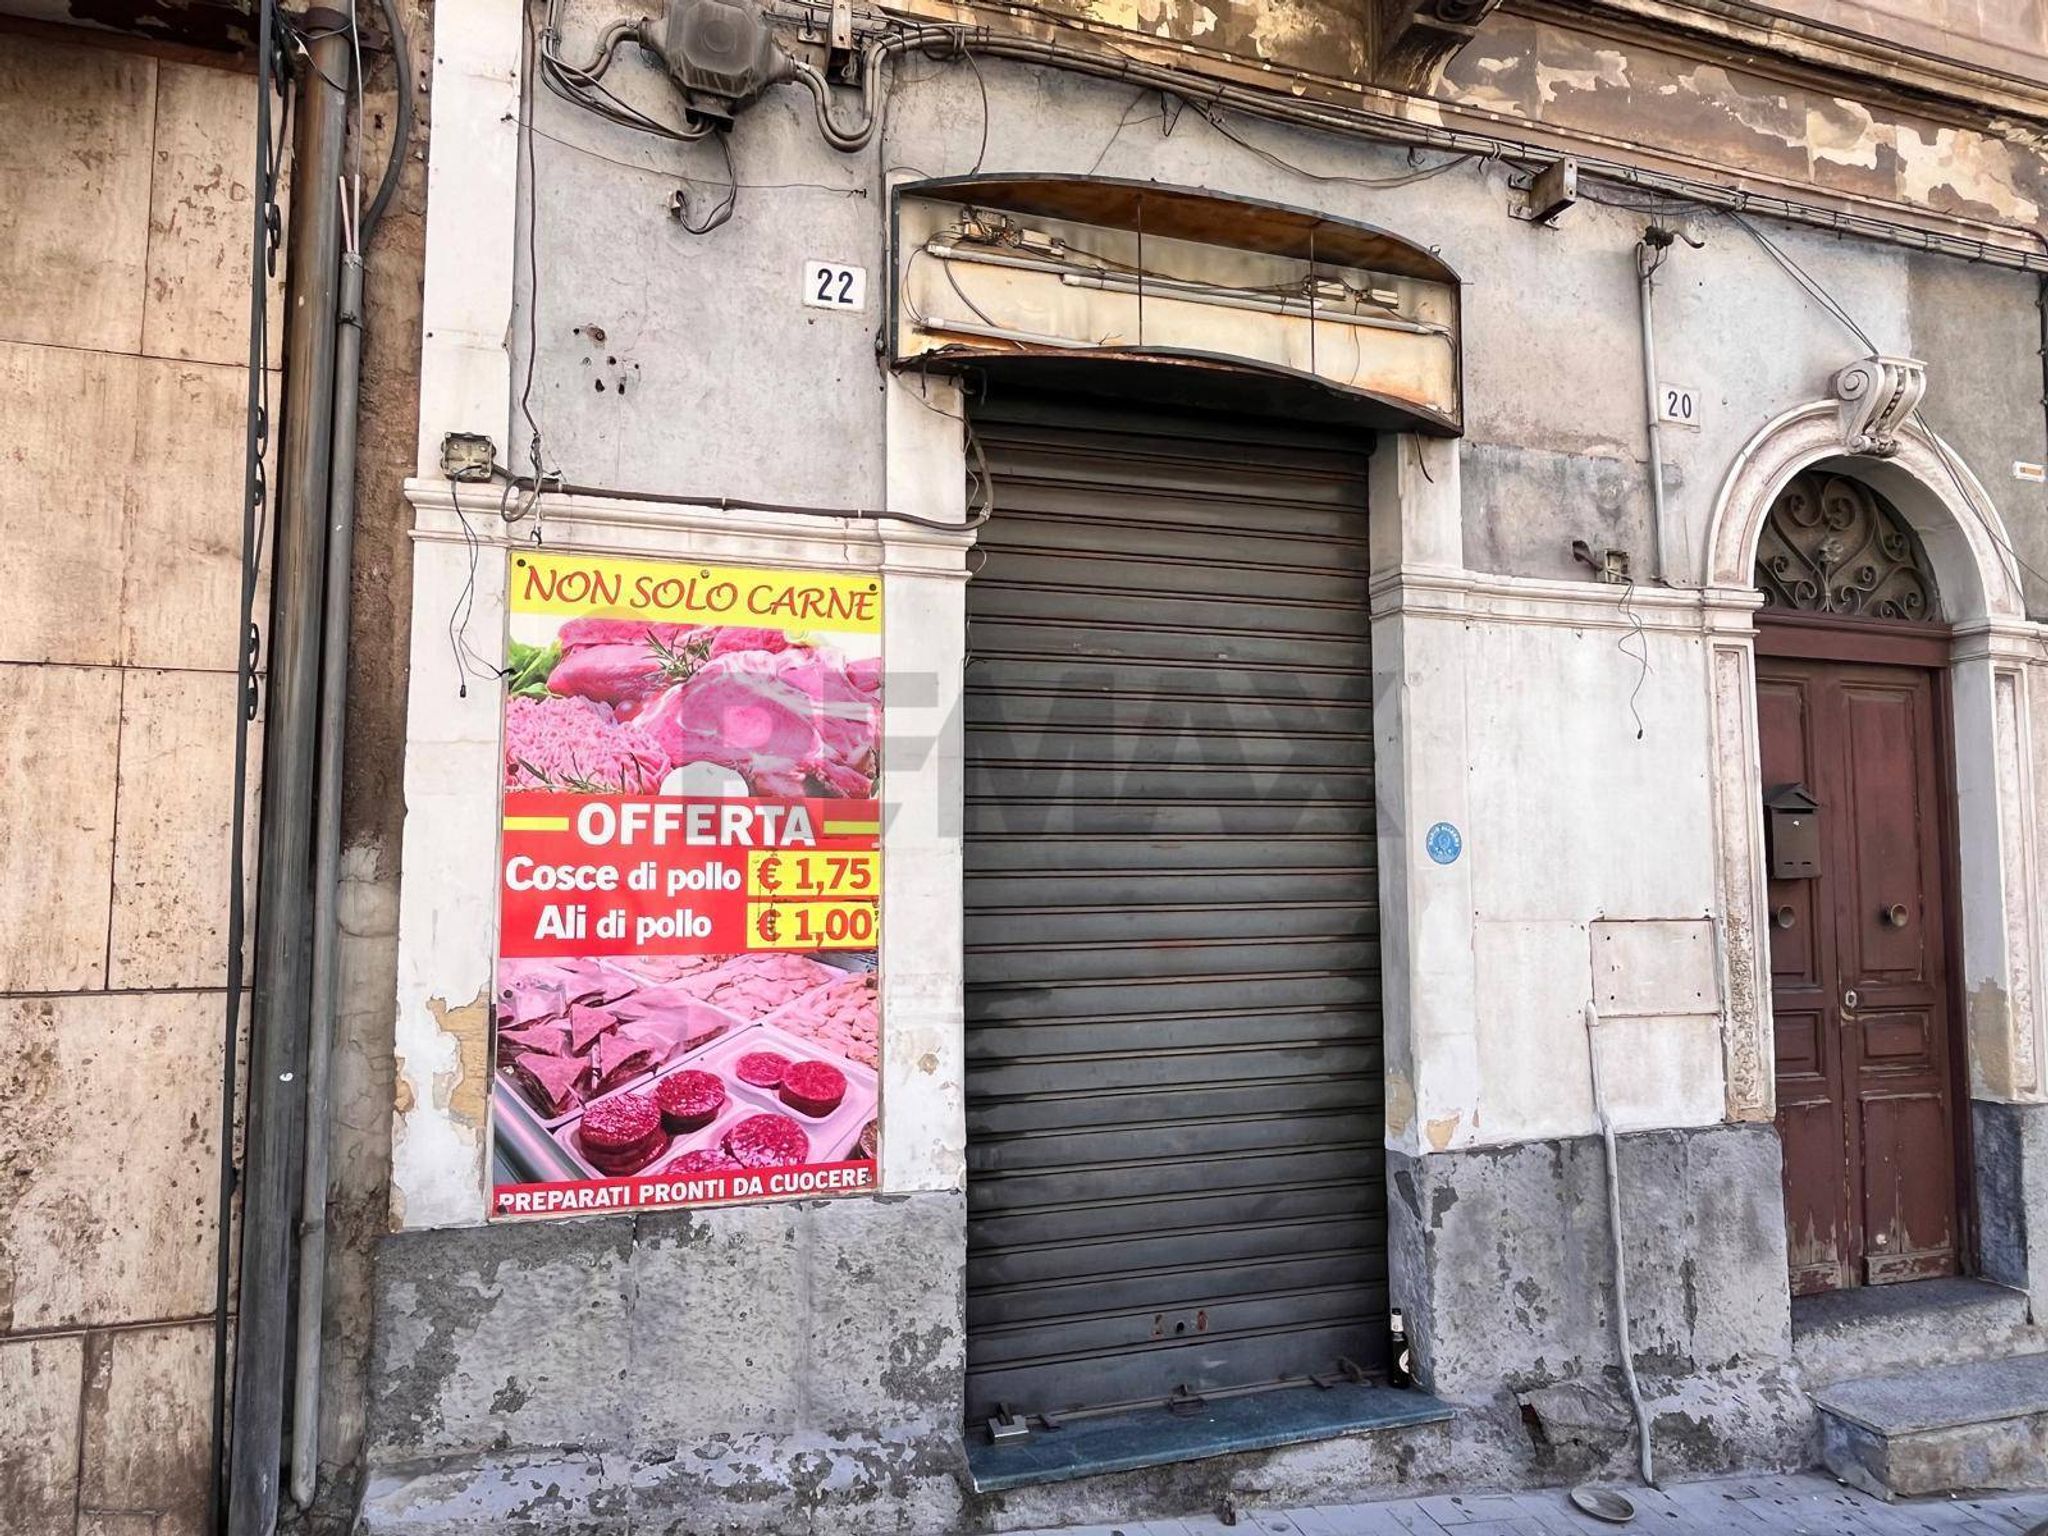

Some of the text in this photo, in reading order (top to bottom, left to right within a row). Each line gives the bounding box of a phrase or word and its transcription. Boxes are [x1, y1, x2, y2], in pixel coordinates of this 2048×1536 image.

[817, 268, 854, 304] 22
[1668, 390, 1692, 419] 20
[524, 565, 880, 622] NON SOLO CARNE
[576, 803, 817, 847] OFFERTA
[504, 856, 619, 892] Cosce
[627, 862, 657, 891] di
[667, 862, 741, 897] pollo
[795, 858, 873, 896] 1,75
[533, 904, 587, 940] Ali
[596, 909, 626, 939] di
[636, 909, 712, 945] pollo
[795, 908, 873, 947] 1,00
[500, 1167, 869, 1213] PREPARATI PRONTI DA CUOCERE
